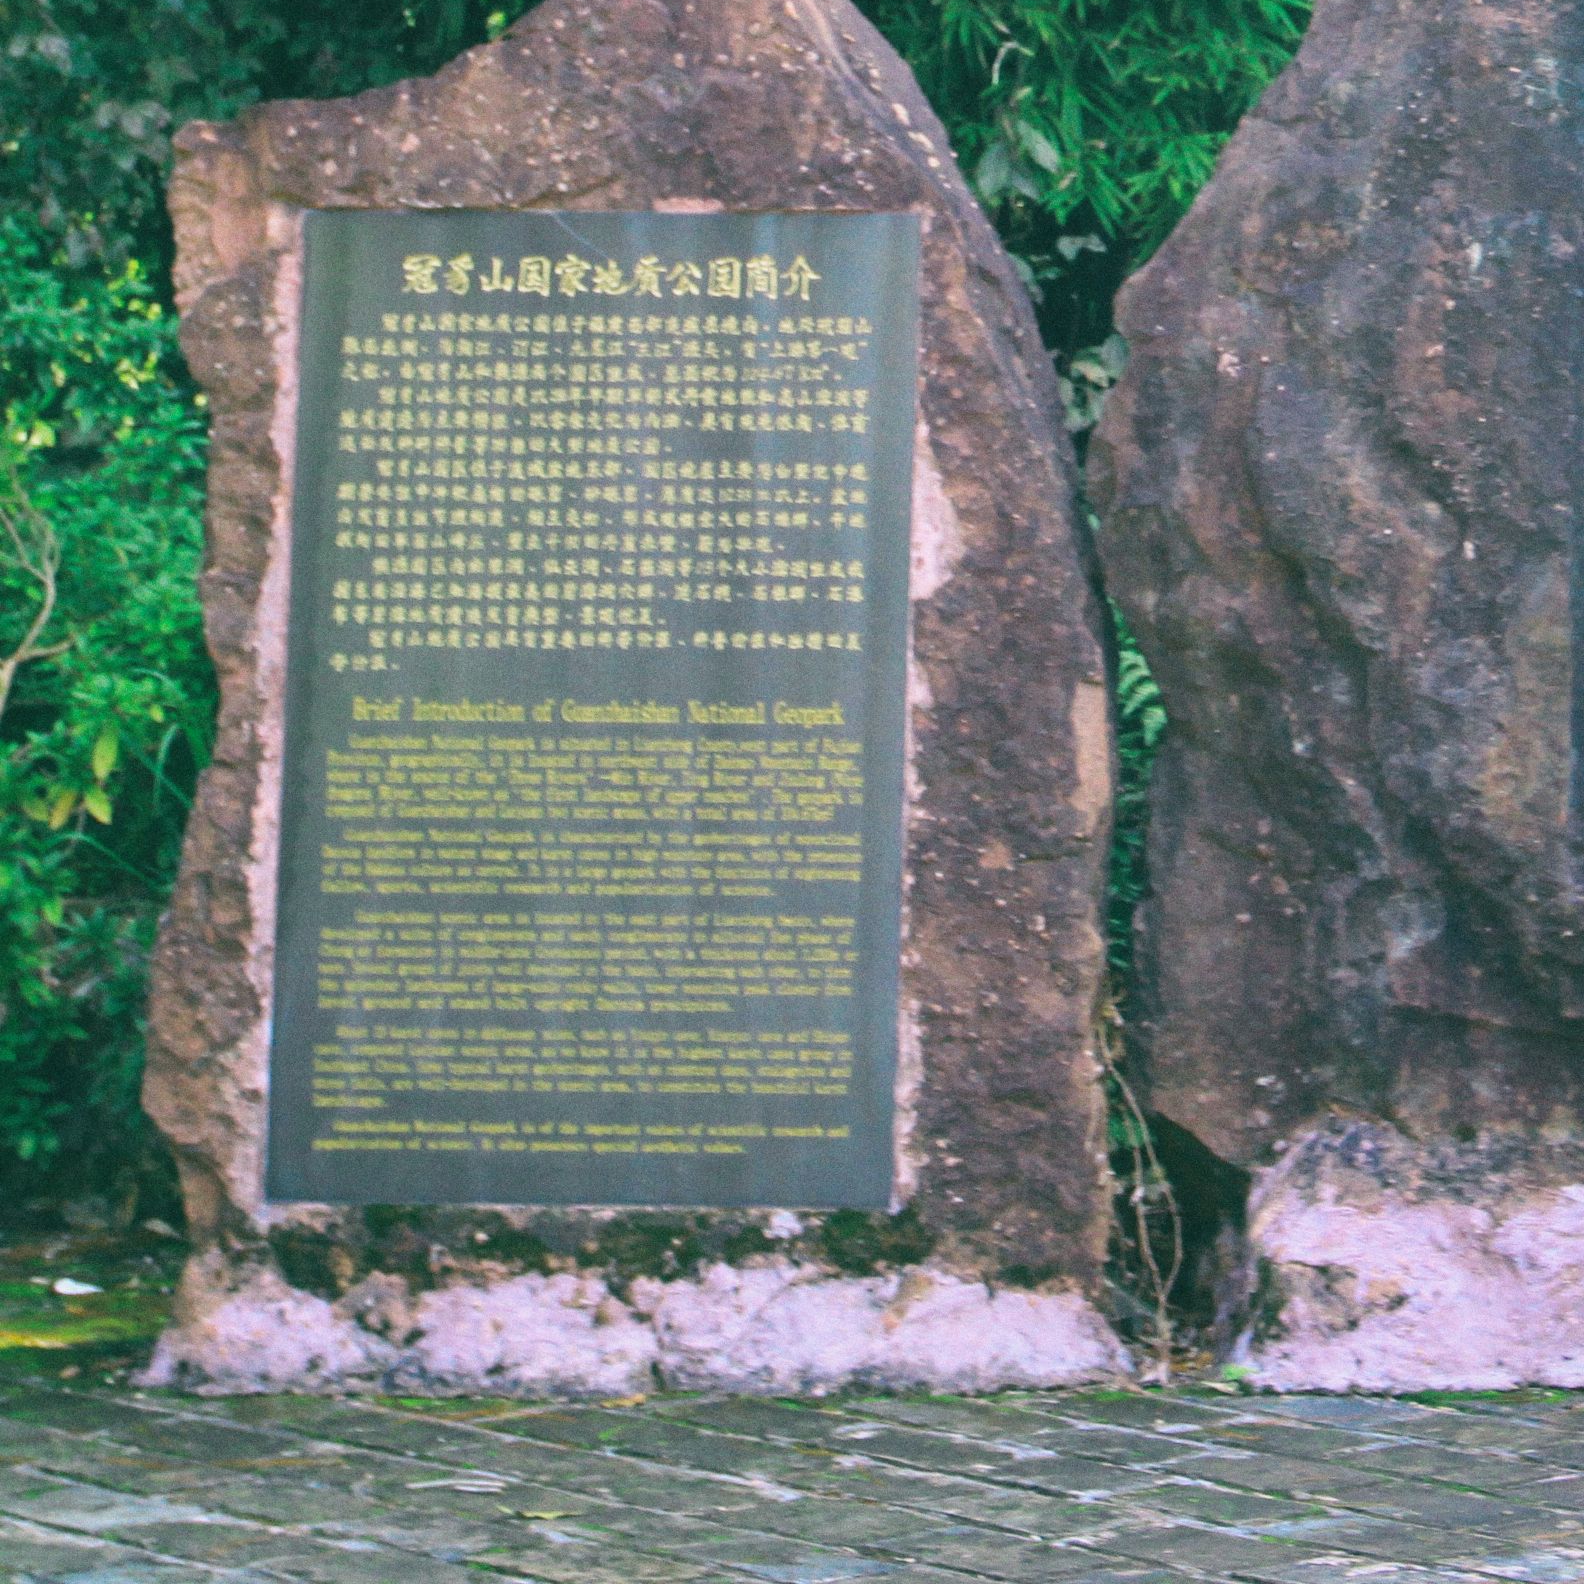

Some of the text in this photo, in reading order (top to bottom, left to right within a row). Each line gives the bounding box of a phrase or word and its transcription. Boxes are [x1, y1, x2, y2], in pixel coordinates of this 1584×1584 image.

[401, 253, 822, 301] 冠豸山国家地质公园简介
[412, 696, 525, 722] Introduction
[532, 698, 555, 722] of
